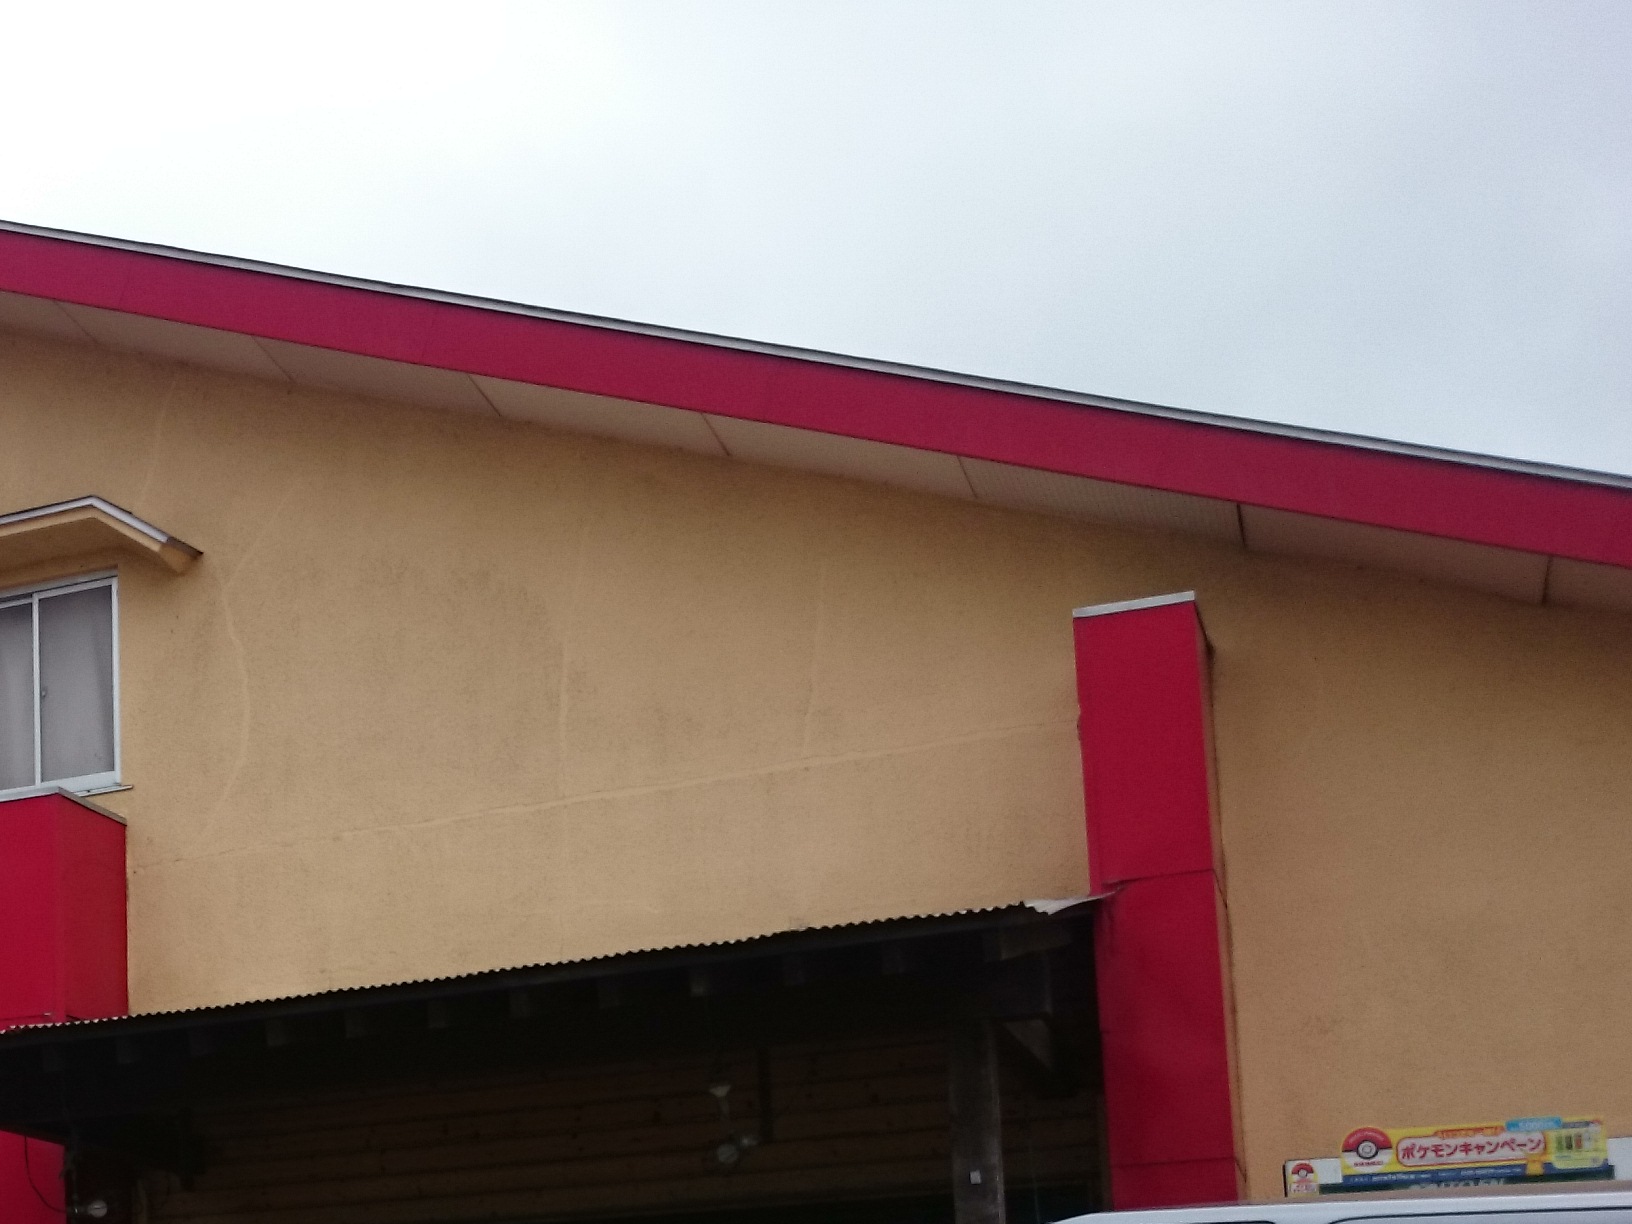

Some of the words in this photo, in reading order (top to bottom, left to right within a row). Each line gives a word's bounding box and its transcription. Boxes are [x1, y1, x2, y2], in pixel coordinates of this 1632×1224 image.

[1401, 1137, 1543, 1161] ポケモンキャンペーン
